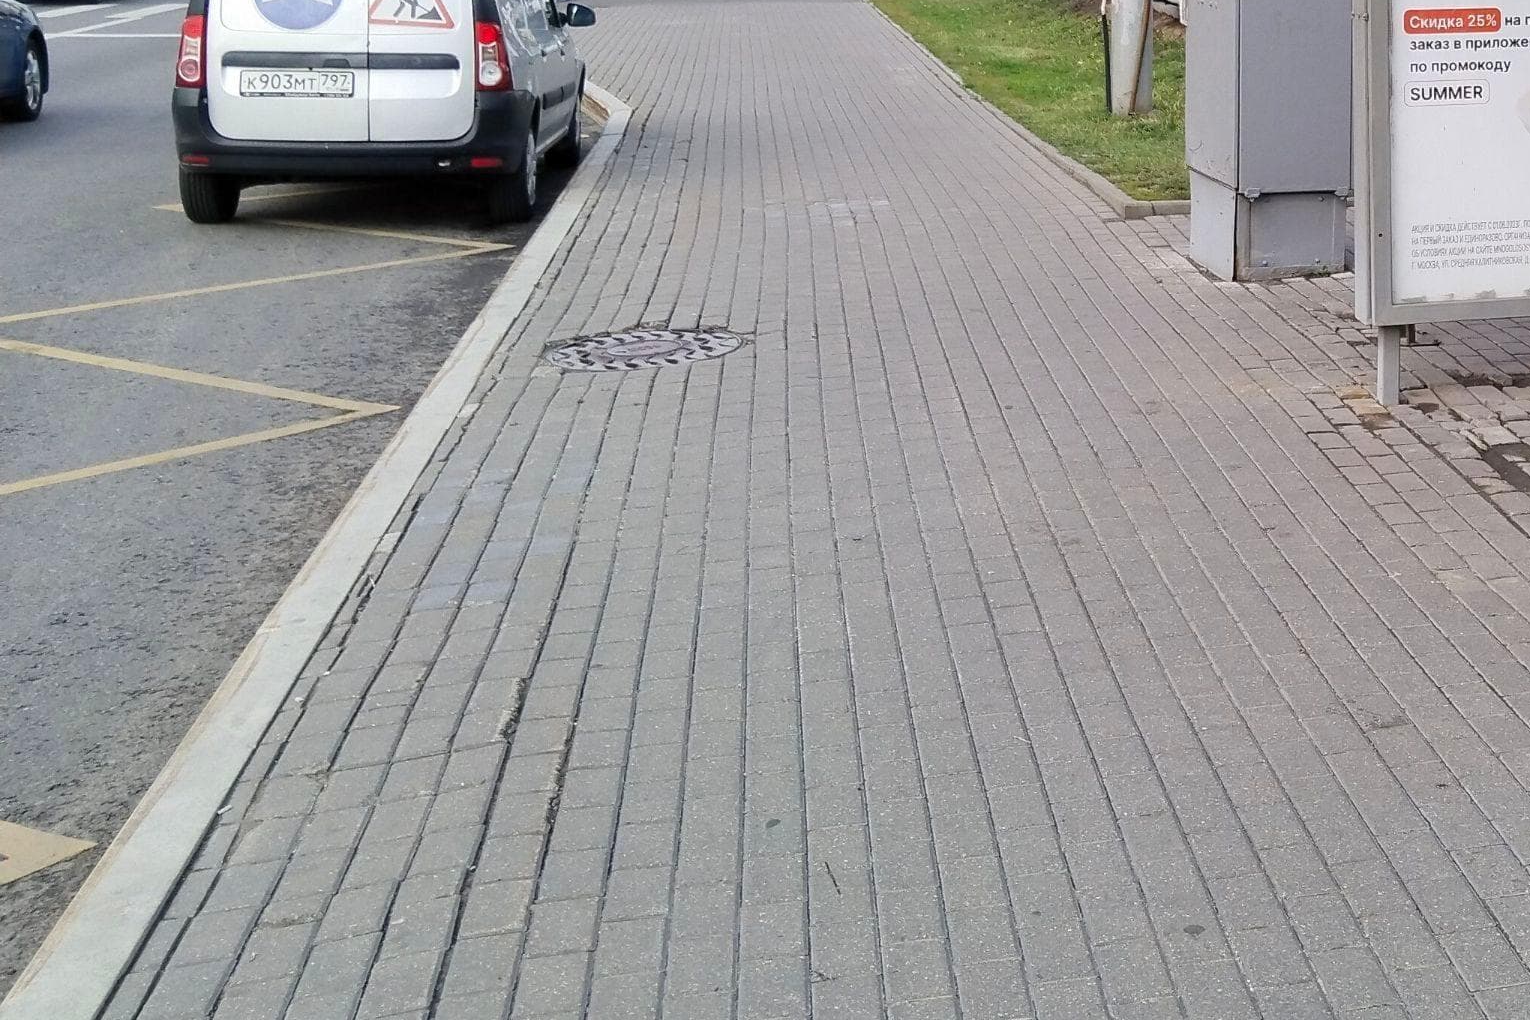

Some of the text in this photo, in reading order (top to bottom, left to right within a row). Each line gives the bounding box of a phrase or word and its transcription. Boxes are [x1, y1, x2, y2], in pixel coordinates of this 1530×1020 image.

[1409, 16, 1464, 30] Скидка
[1468, 14, 1497, 27] 25%
[1504, 17, 1521, 26] на
[1410, 40, 1450, 50] заказ
[1454, 40, 1461, 49] в
[1410, 60, 1511, 75] по промокоду
[247, 73, 348, 90] К903МТ 797
[1410, 85, 1483, 101] SUMMER
